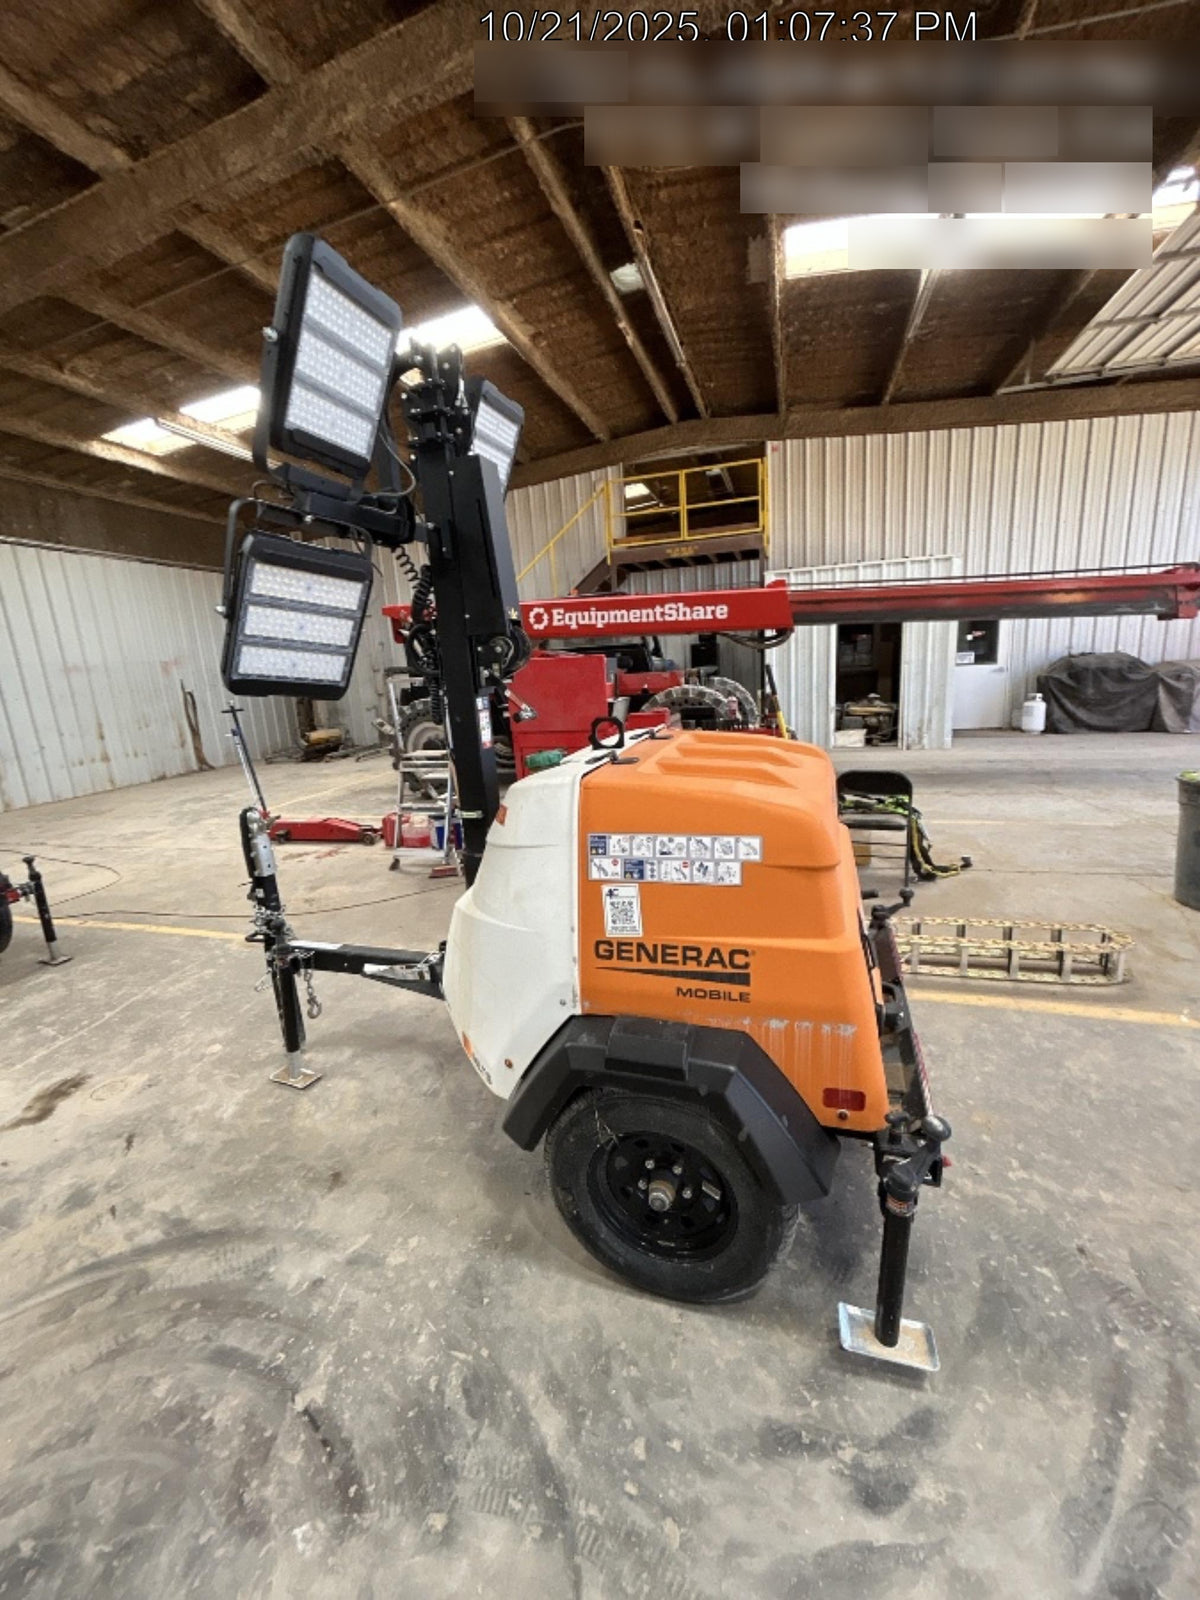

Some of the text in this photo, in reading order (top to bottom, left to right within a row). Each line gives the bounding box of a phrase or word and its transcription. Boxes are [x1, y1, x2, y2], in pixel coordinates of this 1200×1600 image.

[552, 602, 729, 629] EquipmentShare
[594, 939, 751, 970] GENERAC
[676, 986, 751, 1003] MOBILE
